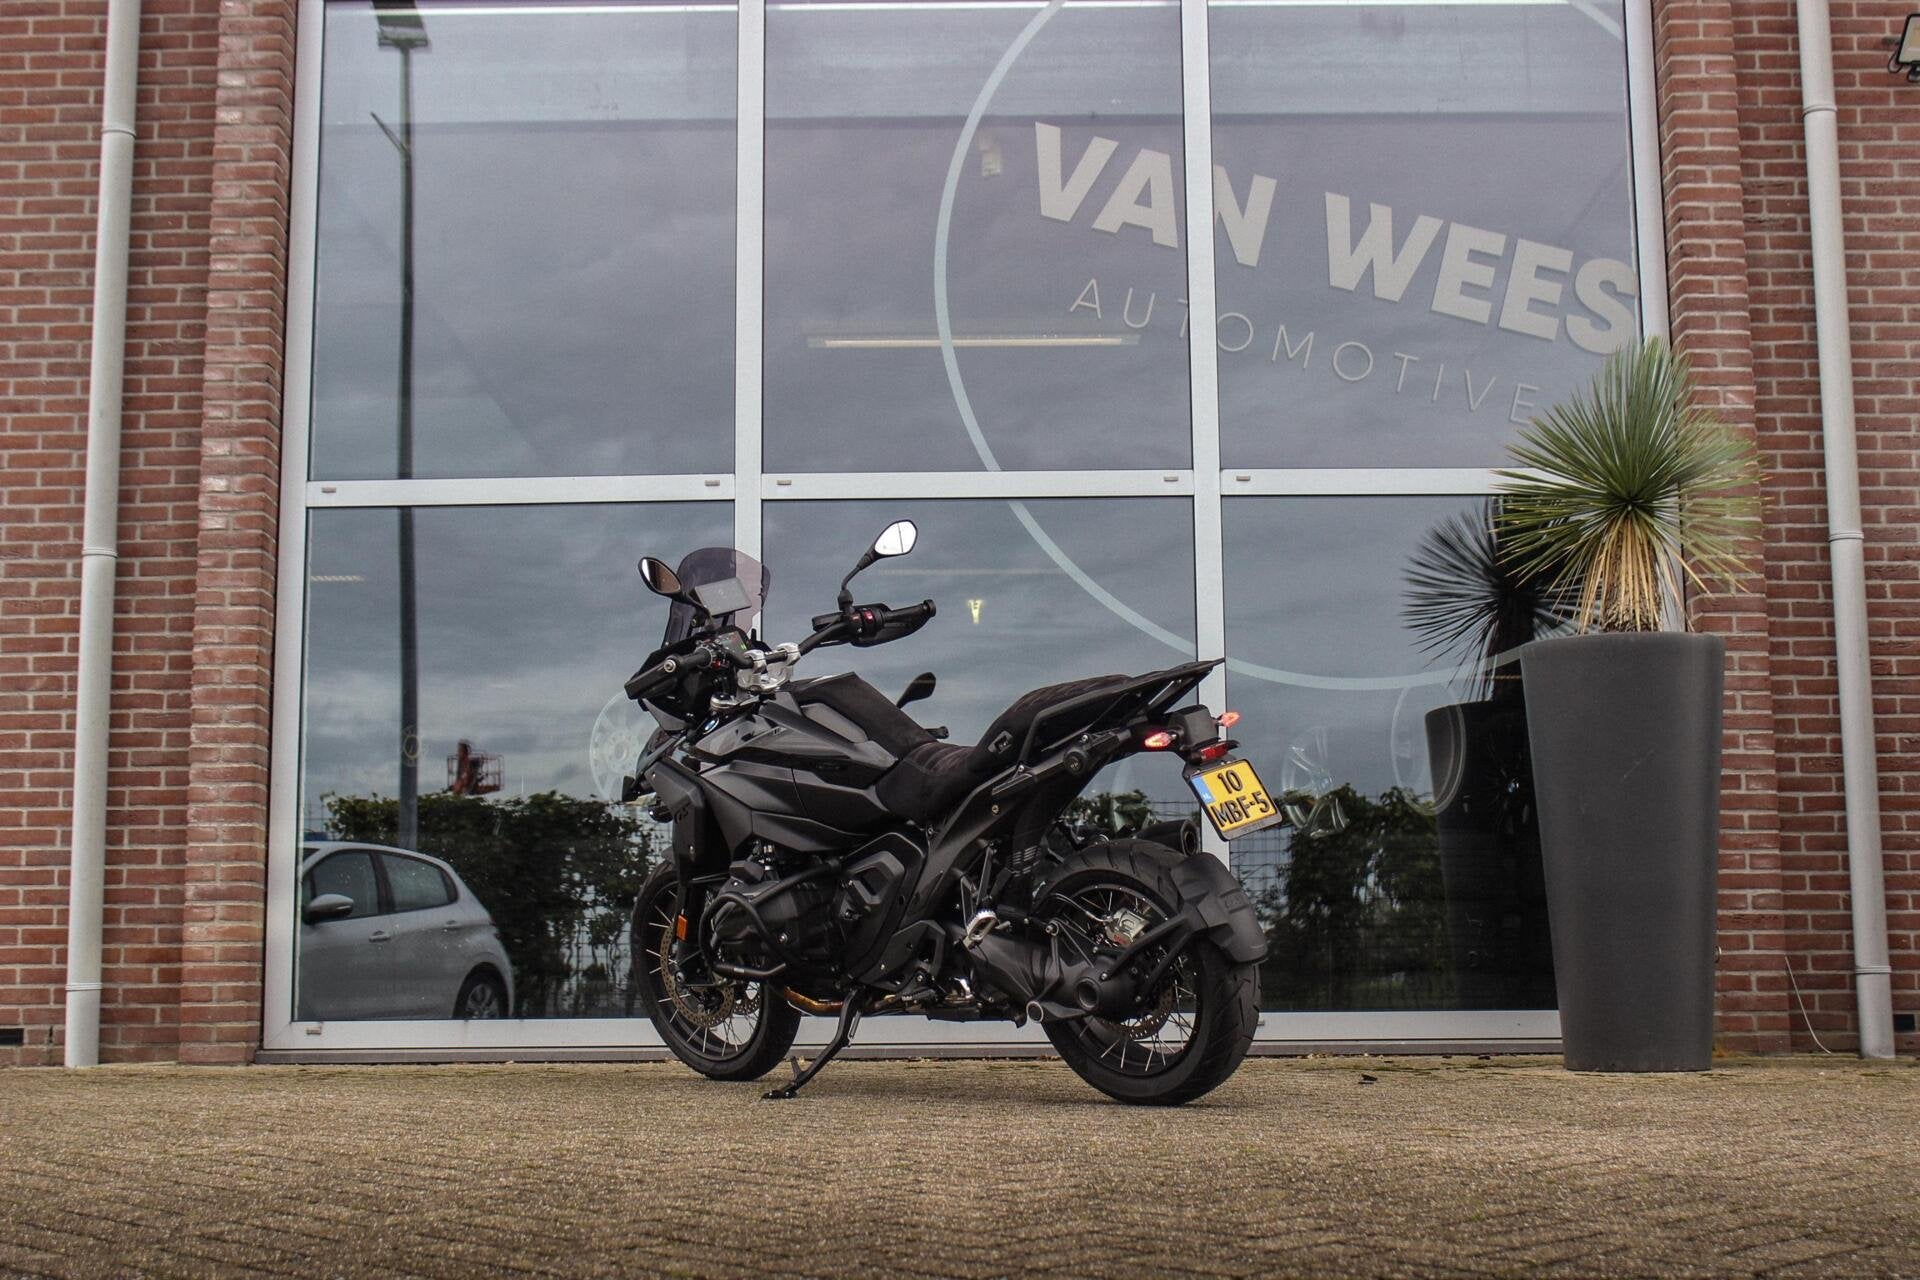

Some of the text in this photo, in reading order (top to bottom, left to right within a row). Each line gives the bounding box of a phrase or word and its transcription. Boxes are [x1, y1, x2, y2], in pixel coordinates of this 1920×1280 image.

[1035, 122, 1639, 355] VAN WEES
[1070, 277, 1539, 425] AUTOMOTIVE
[1211, 792, 1270, 827] MBF-5
[1218, 770, 1242, 793] 10
